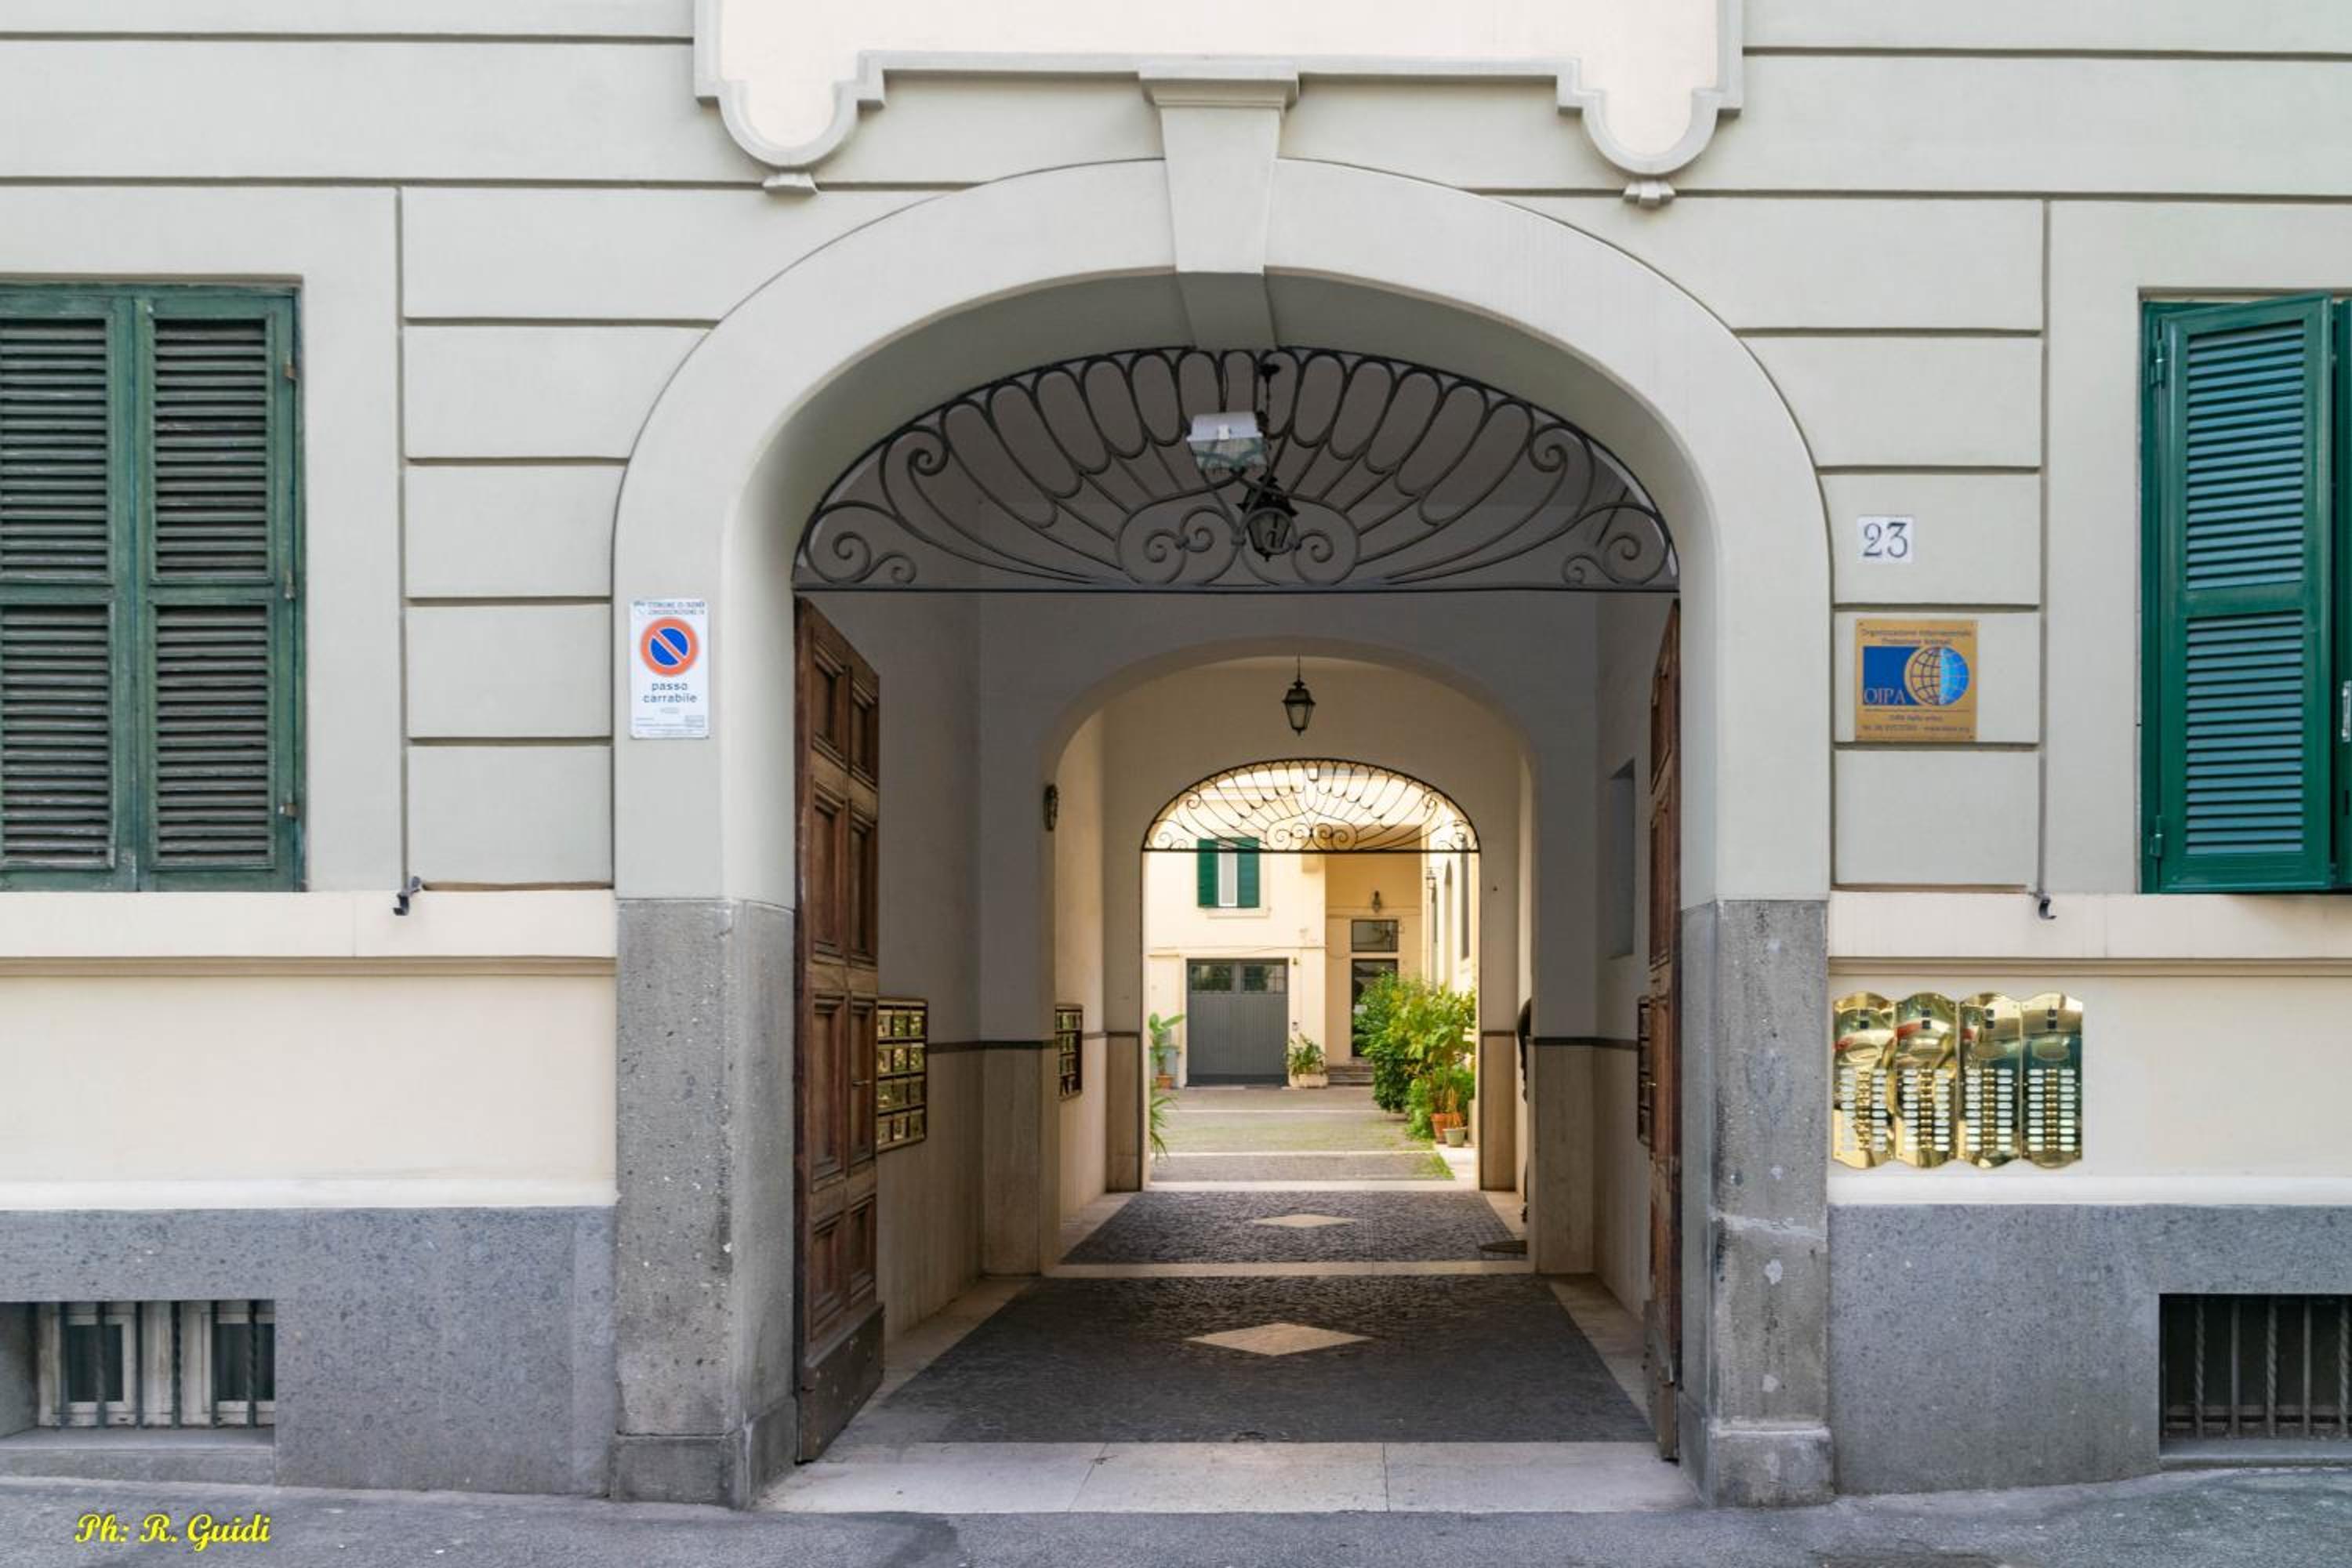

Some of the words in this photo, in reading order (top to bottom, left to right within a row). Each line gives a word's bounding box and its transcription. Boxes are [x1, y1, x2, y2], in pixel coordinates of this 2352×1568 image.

[1863, 521, 1908, 558] 23
[652, 683, 688, 692] passo
[643, 693, 698, 703] carrabile
[1864, 687, 1907, 705] OIPA
